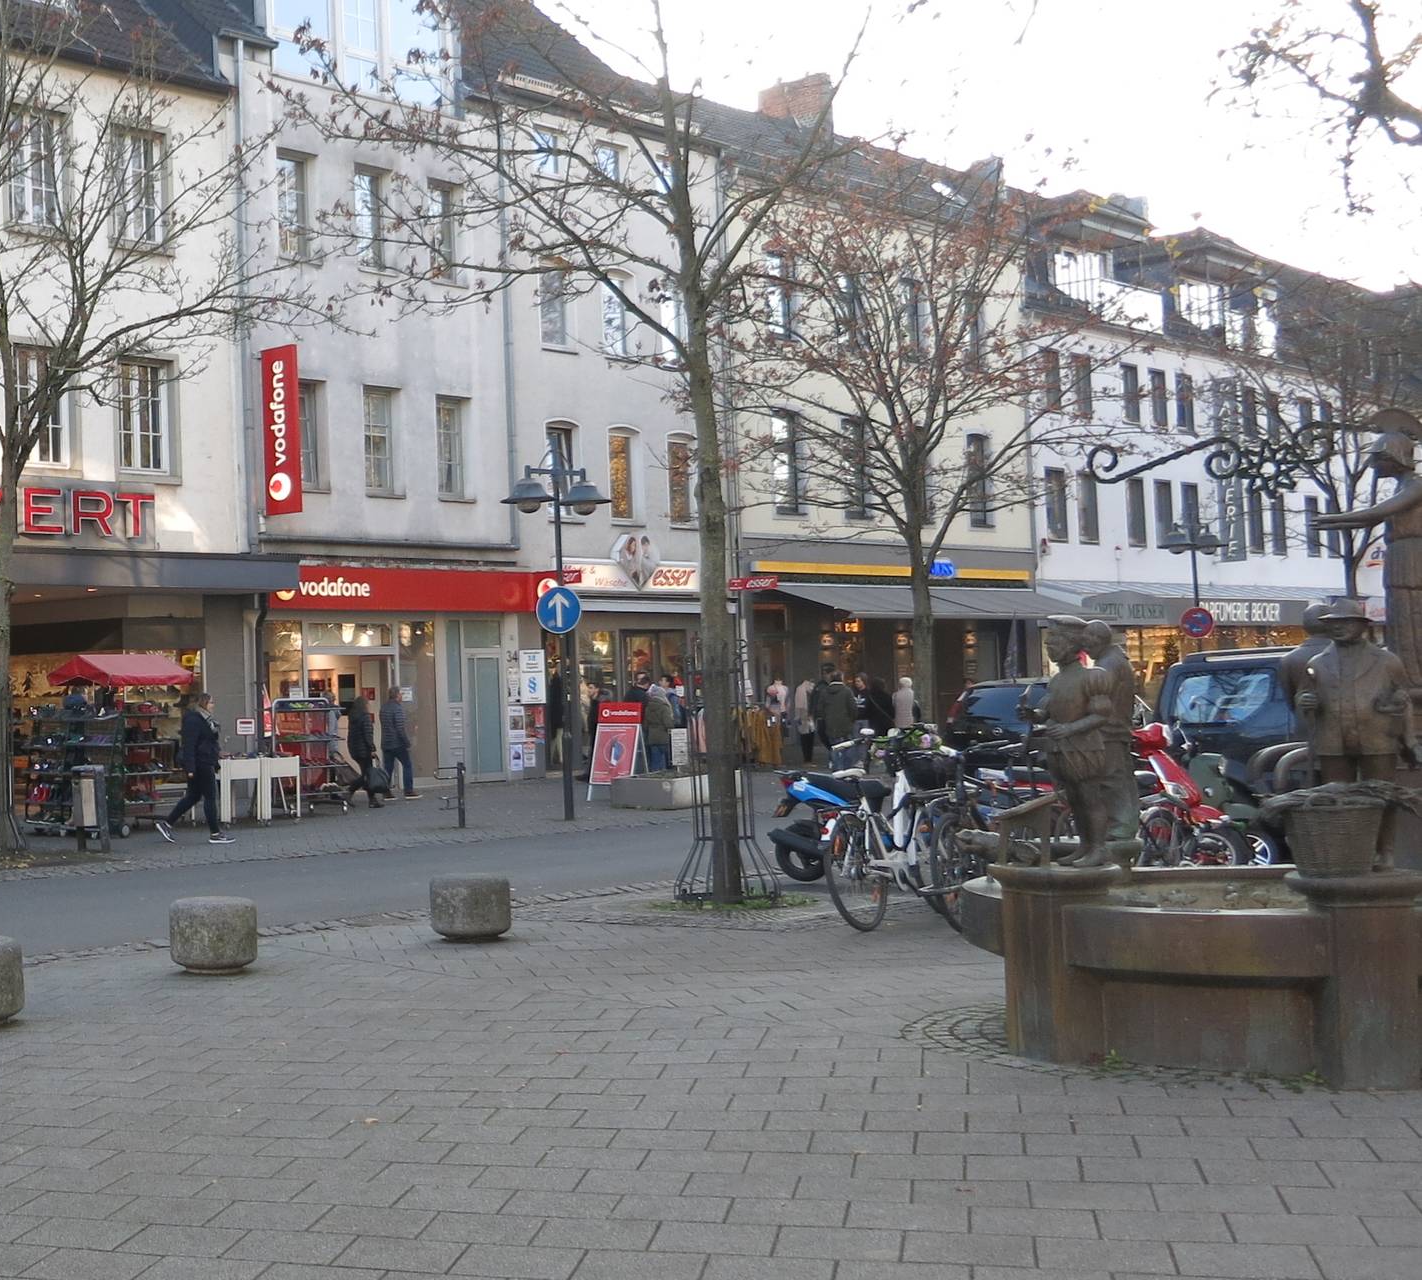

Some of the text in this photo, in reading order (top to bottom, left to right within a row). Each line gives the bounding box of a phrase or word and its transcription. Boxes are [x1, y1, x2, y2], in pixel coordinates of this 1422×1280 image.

[269, 360, 287, 466] vodafone
[299, 576, 371, 598] vodafone
[652, 569, 695, 587] esser
[1251, 602, 1281, 622] BECKER
[506, 650, 518, 663] 34
